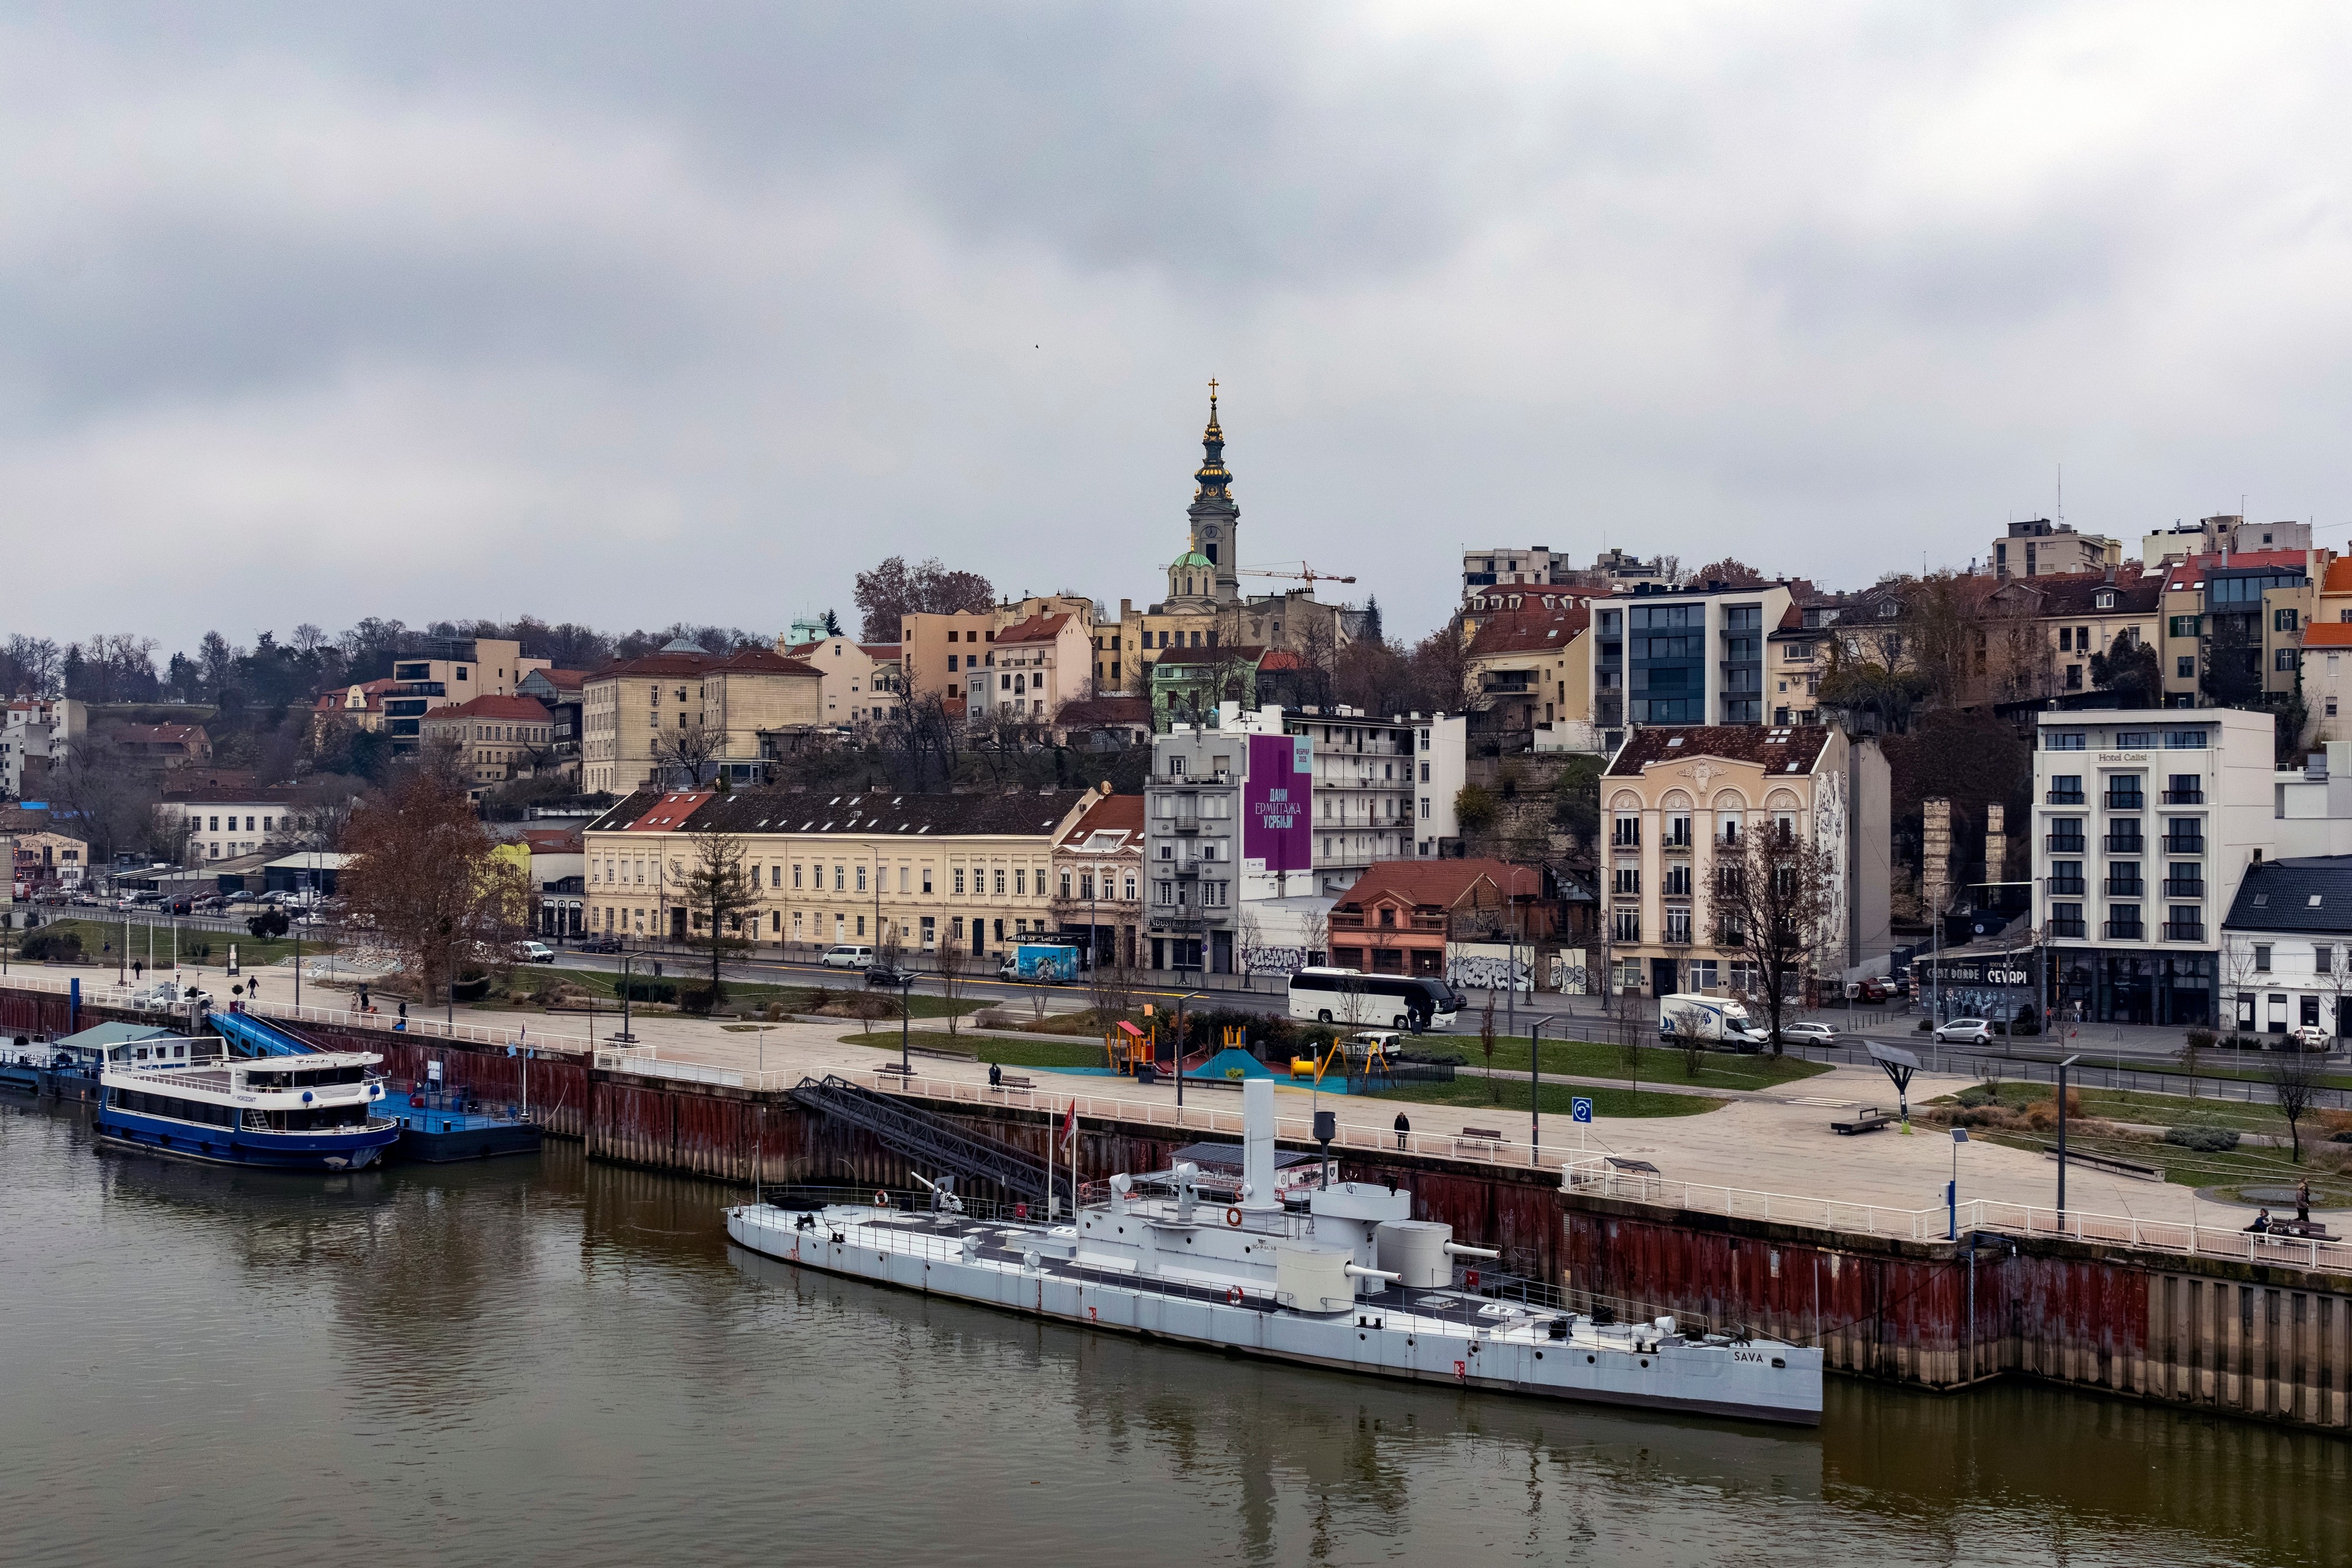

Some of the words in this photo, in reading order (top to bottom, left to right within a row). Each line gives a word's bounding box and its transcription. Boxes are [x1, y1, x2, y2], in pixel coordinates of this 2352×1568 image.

[1269, 788, 1288, 802] ДАНИ
[1255, 803, 1301, 815] ЕРМИТАЖА
[1264, 815, 1268, 829] У
[1268, 815, 1293, 828] СРБИЈИ
[1734, 1351, 1763, 1363] SAVA
